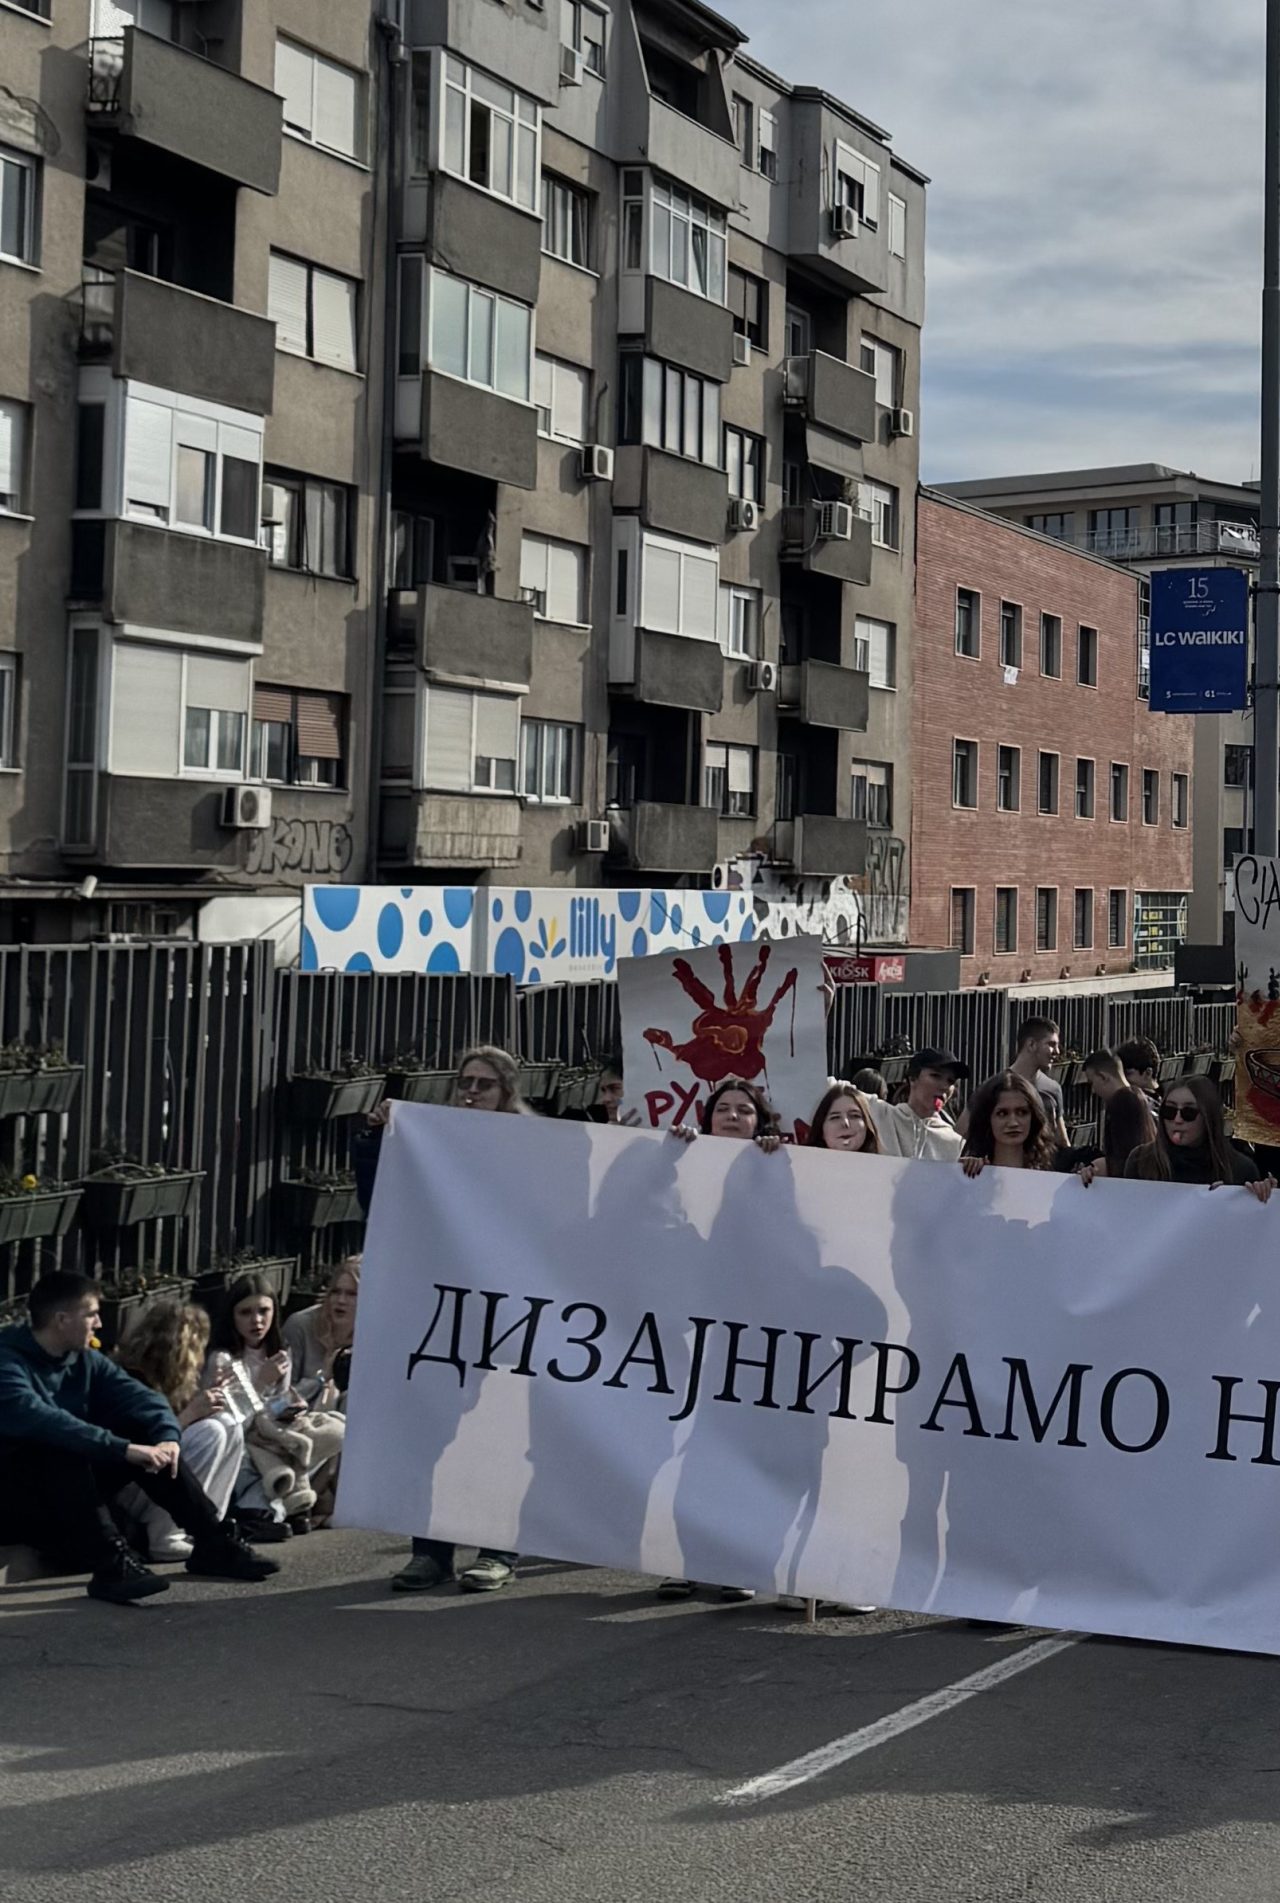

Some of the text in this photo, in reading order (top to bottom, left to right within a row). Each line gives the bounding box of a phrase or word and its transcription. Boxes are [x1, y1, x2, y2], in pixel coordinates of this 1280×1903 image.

[1189, 578, 1209, 598] 15
[1155, 632, 1175, 646] LC
[570, 896, 616, 974] lilly
[407, 1284, 1169, 1453] ДИЗАЈНИРАМО
